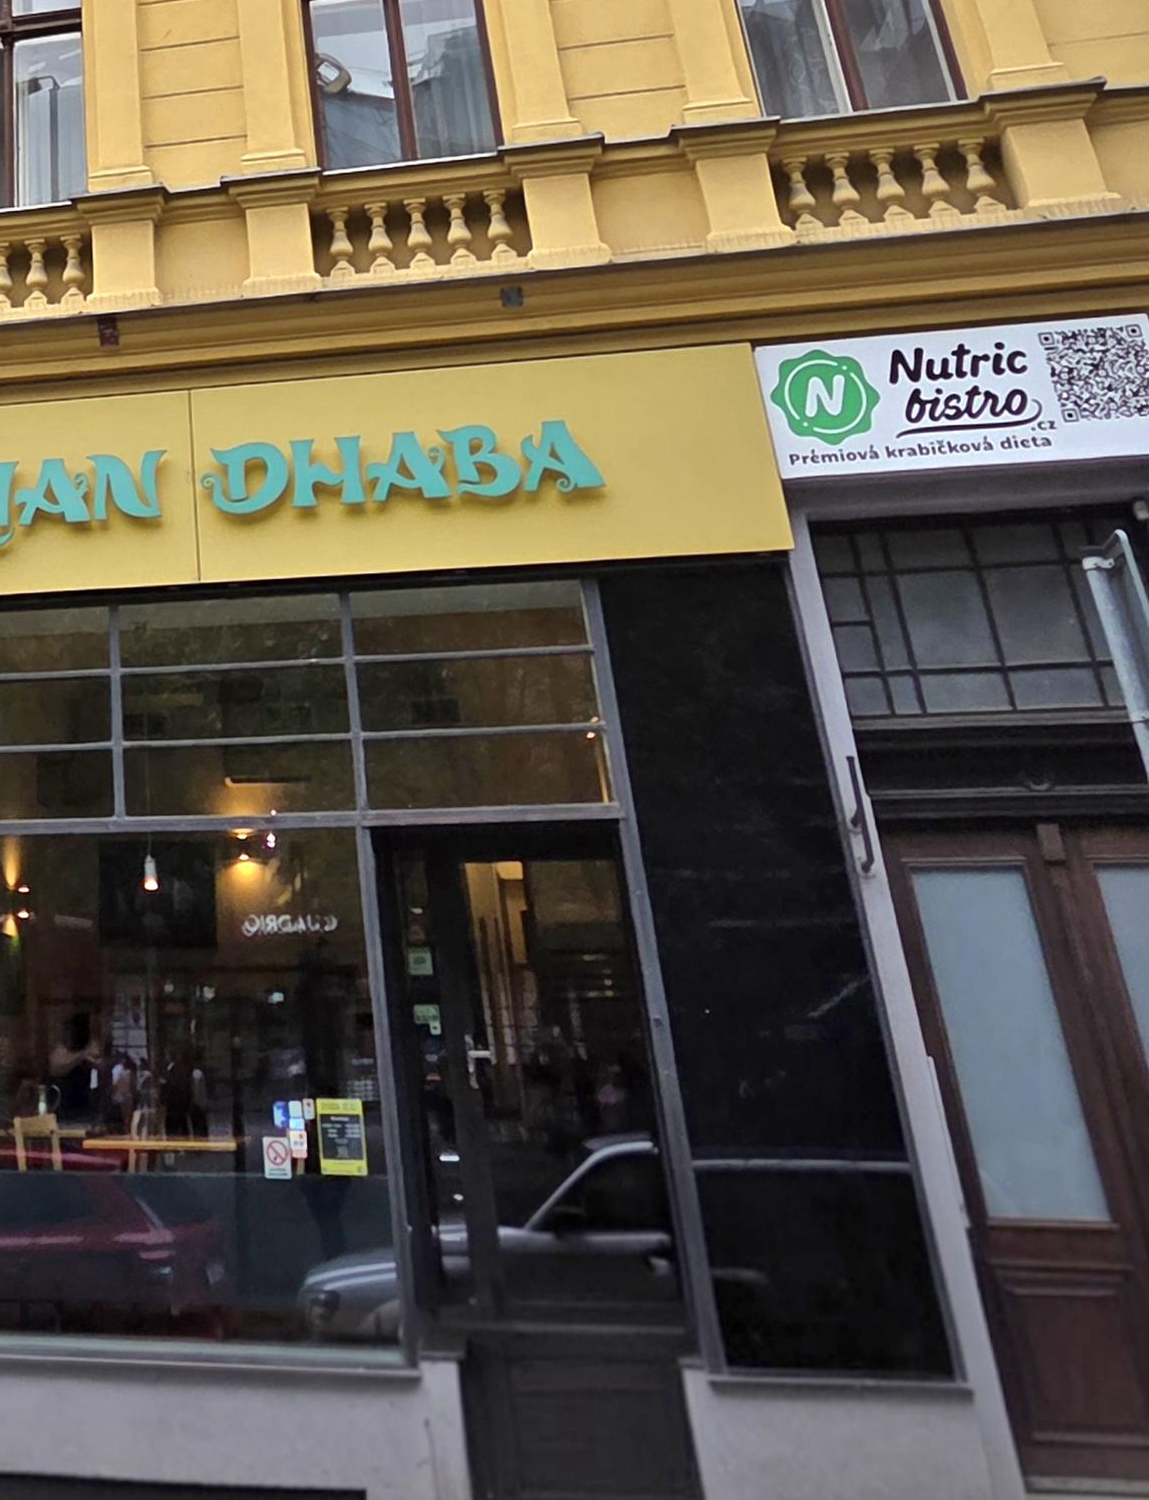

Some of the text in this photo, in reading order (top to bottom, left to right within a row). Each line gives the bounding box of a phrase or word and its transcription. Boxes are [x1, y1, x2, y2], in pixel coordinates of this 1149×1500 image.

[889, 342, 1028, 384] Nutric
[804, 373, 846, 418] N
[905, 385, 1030, 424] bistro
[201, 419, 608, 516] DHABA
[789, 435, 1052, 466] Prémiová krabičková dieta
